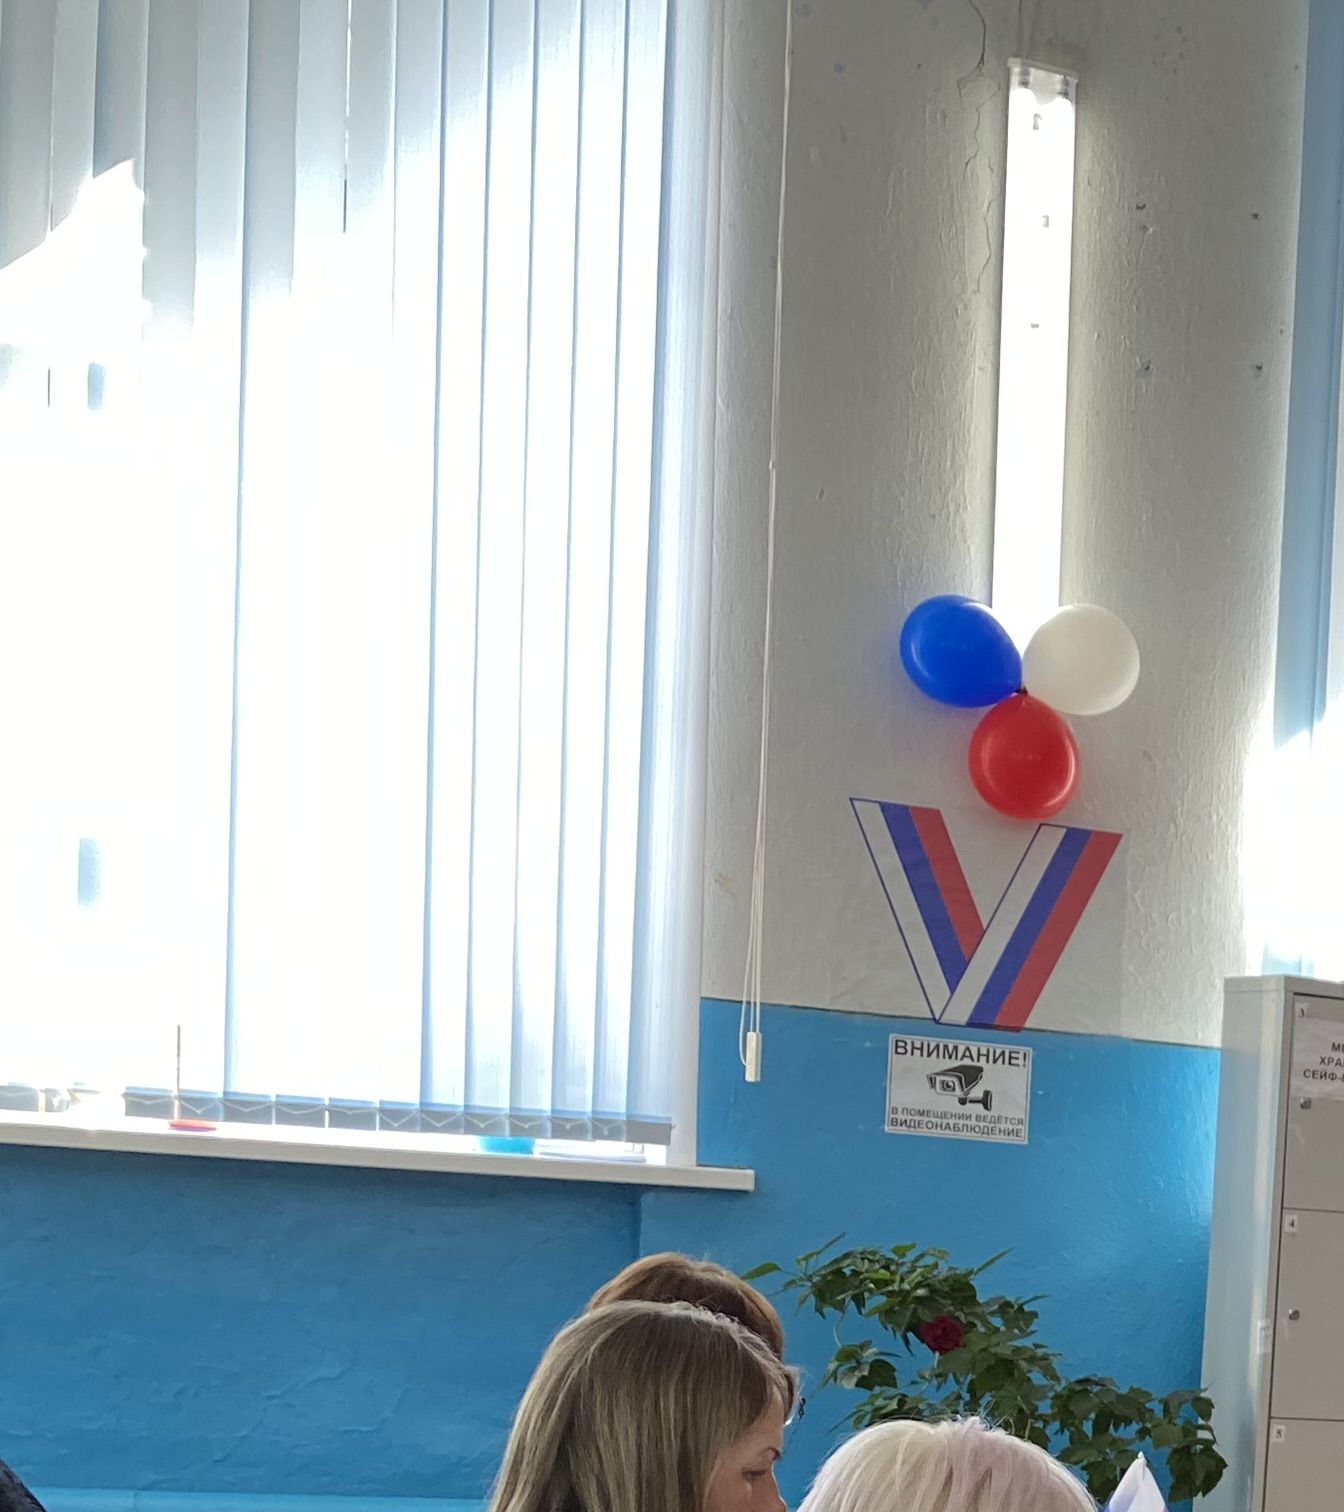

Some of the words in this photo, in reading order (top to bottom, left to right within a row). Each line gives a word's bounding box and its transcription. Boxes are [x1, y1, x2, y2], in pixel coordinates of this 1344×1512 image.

[894, 1039, 1027, 1068] ВНИМАНИЕ!
[891, 1106, 898, 1115] В
[901, 1107, 972, 1121] ПОМЕЩЕНИИ
[890, 1117, 1023, 1138] ВИДЕОНАБЛЮДЕНИЕ
